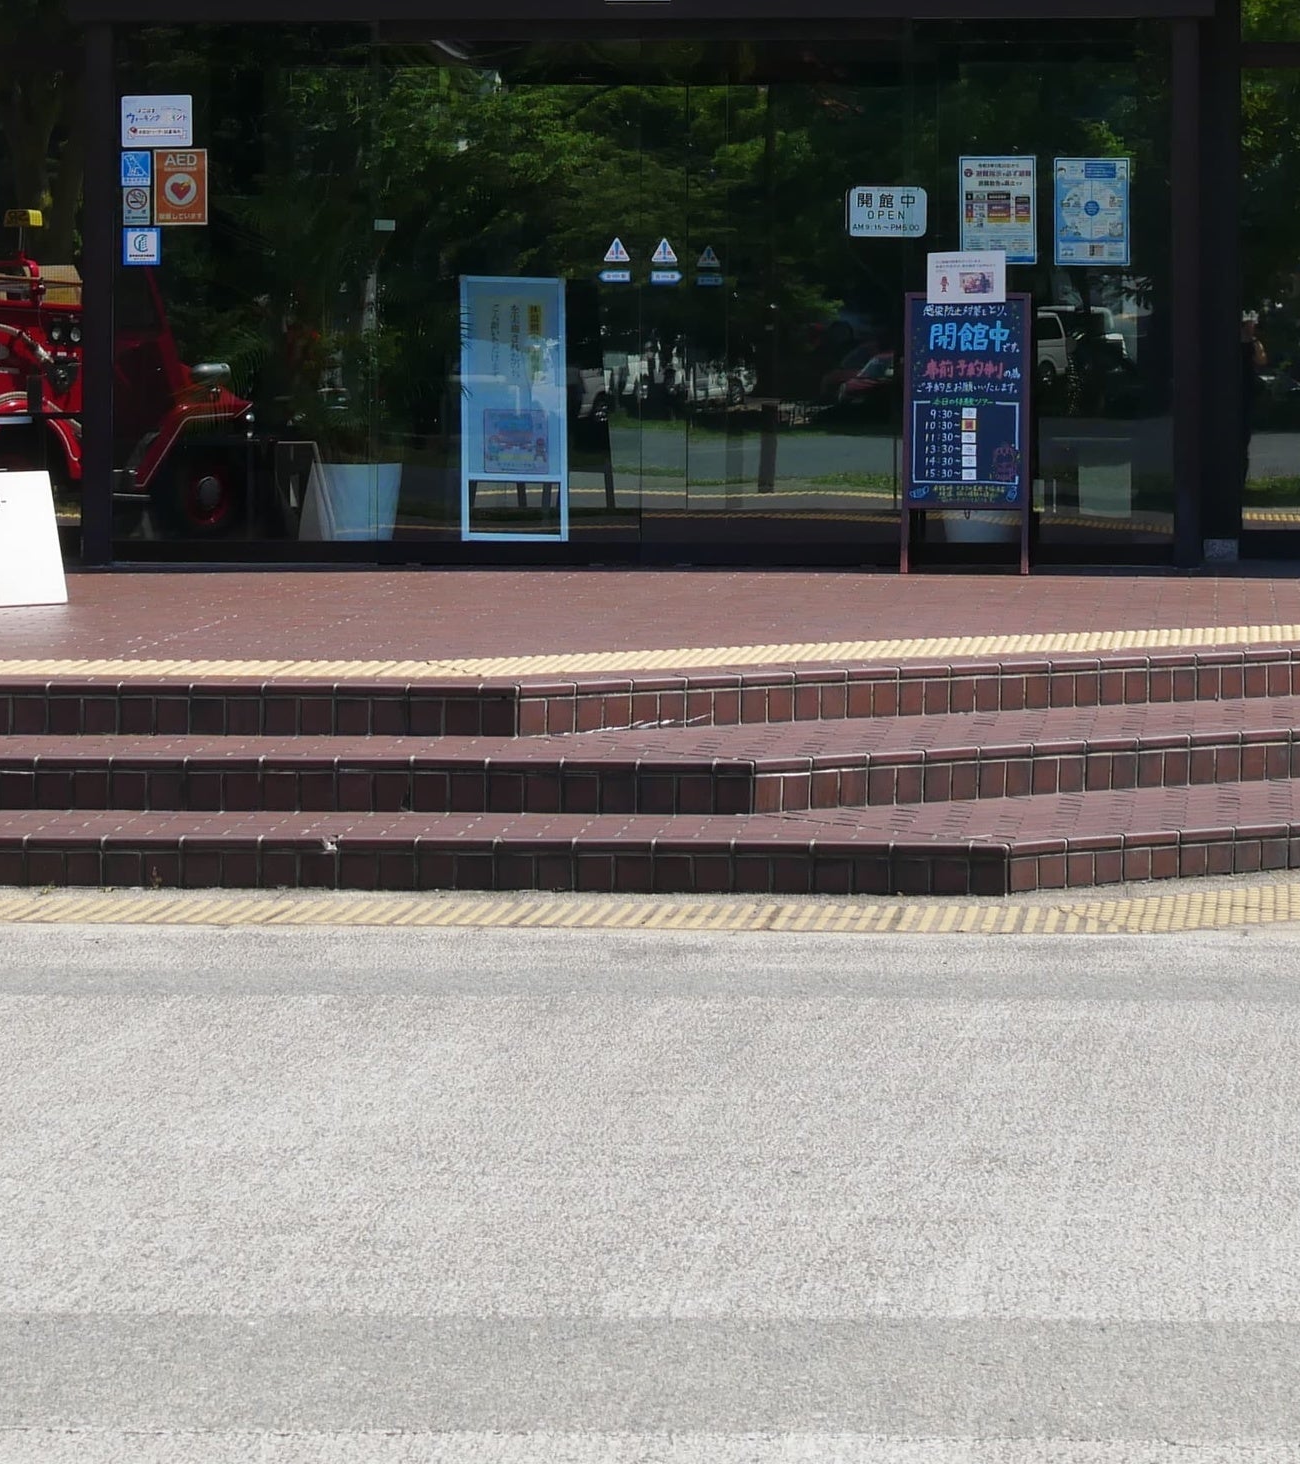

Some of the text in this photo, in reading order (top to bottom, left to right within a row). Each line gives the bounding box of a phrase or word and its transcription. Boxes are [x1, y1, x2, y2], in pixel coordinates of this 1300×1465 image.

[164, 153, 198, 166] AED
[857, 192, 916, 209] 開館中
[867, 210, 906, 220] OPEN
